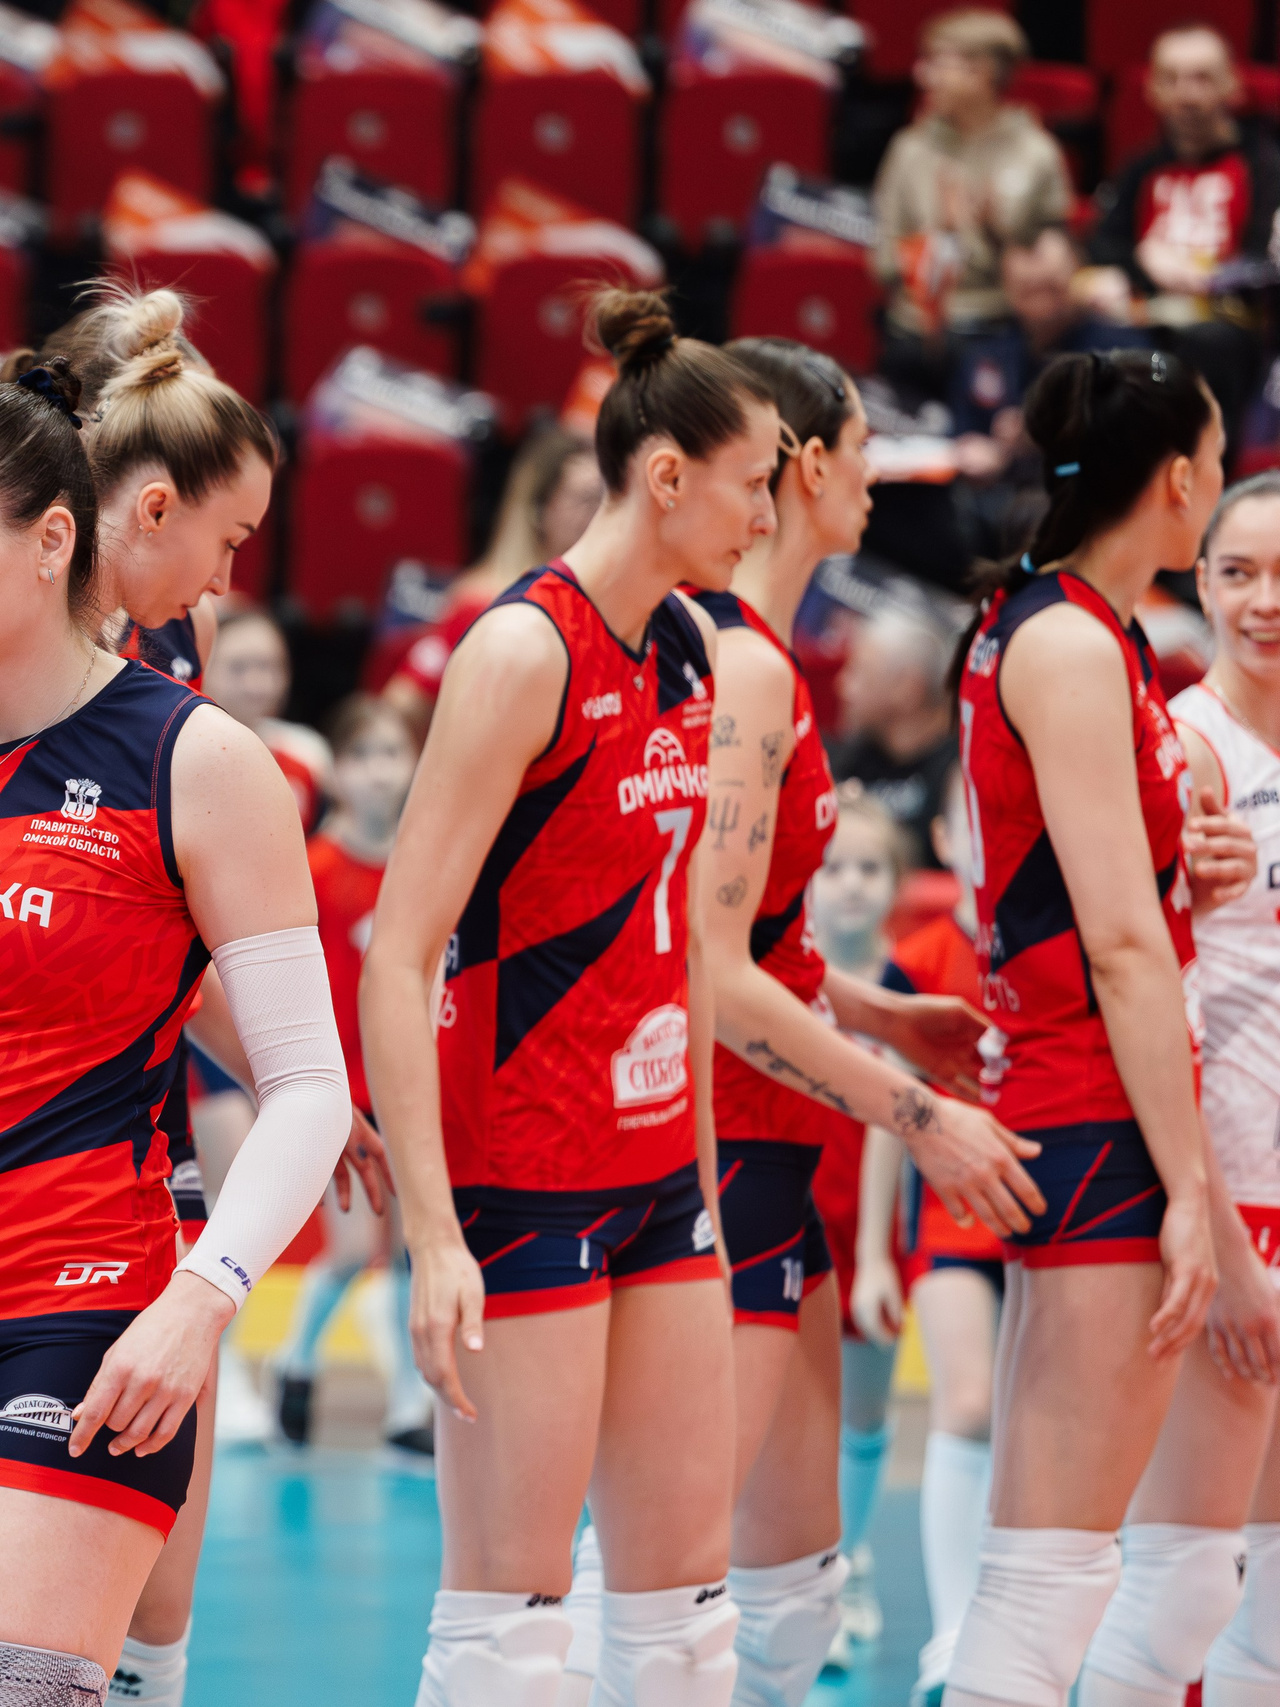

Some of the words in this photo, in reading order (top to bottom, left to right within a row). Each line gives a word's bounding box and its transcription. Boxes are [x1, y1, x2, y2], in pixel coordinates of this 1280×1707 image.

[30, 819, 120, 845] ПРАВИТЕЛЬСТВО
[23, 832, 69, 847] ОМСКОЙ
[68, 838, 121, 861] ОБЛАСТИ
[654, 806, 693, 955] 7
[35, 1430, 67, 1443] СПОНСОР
